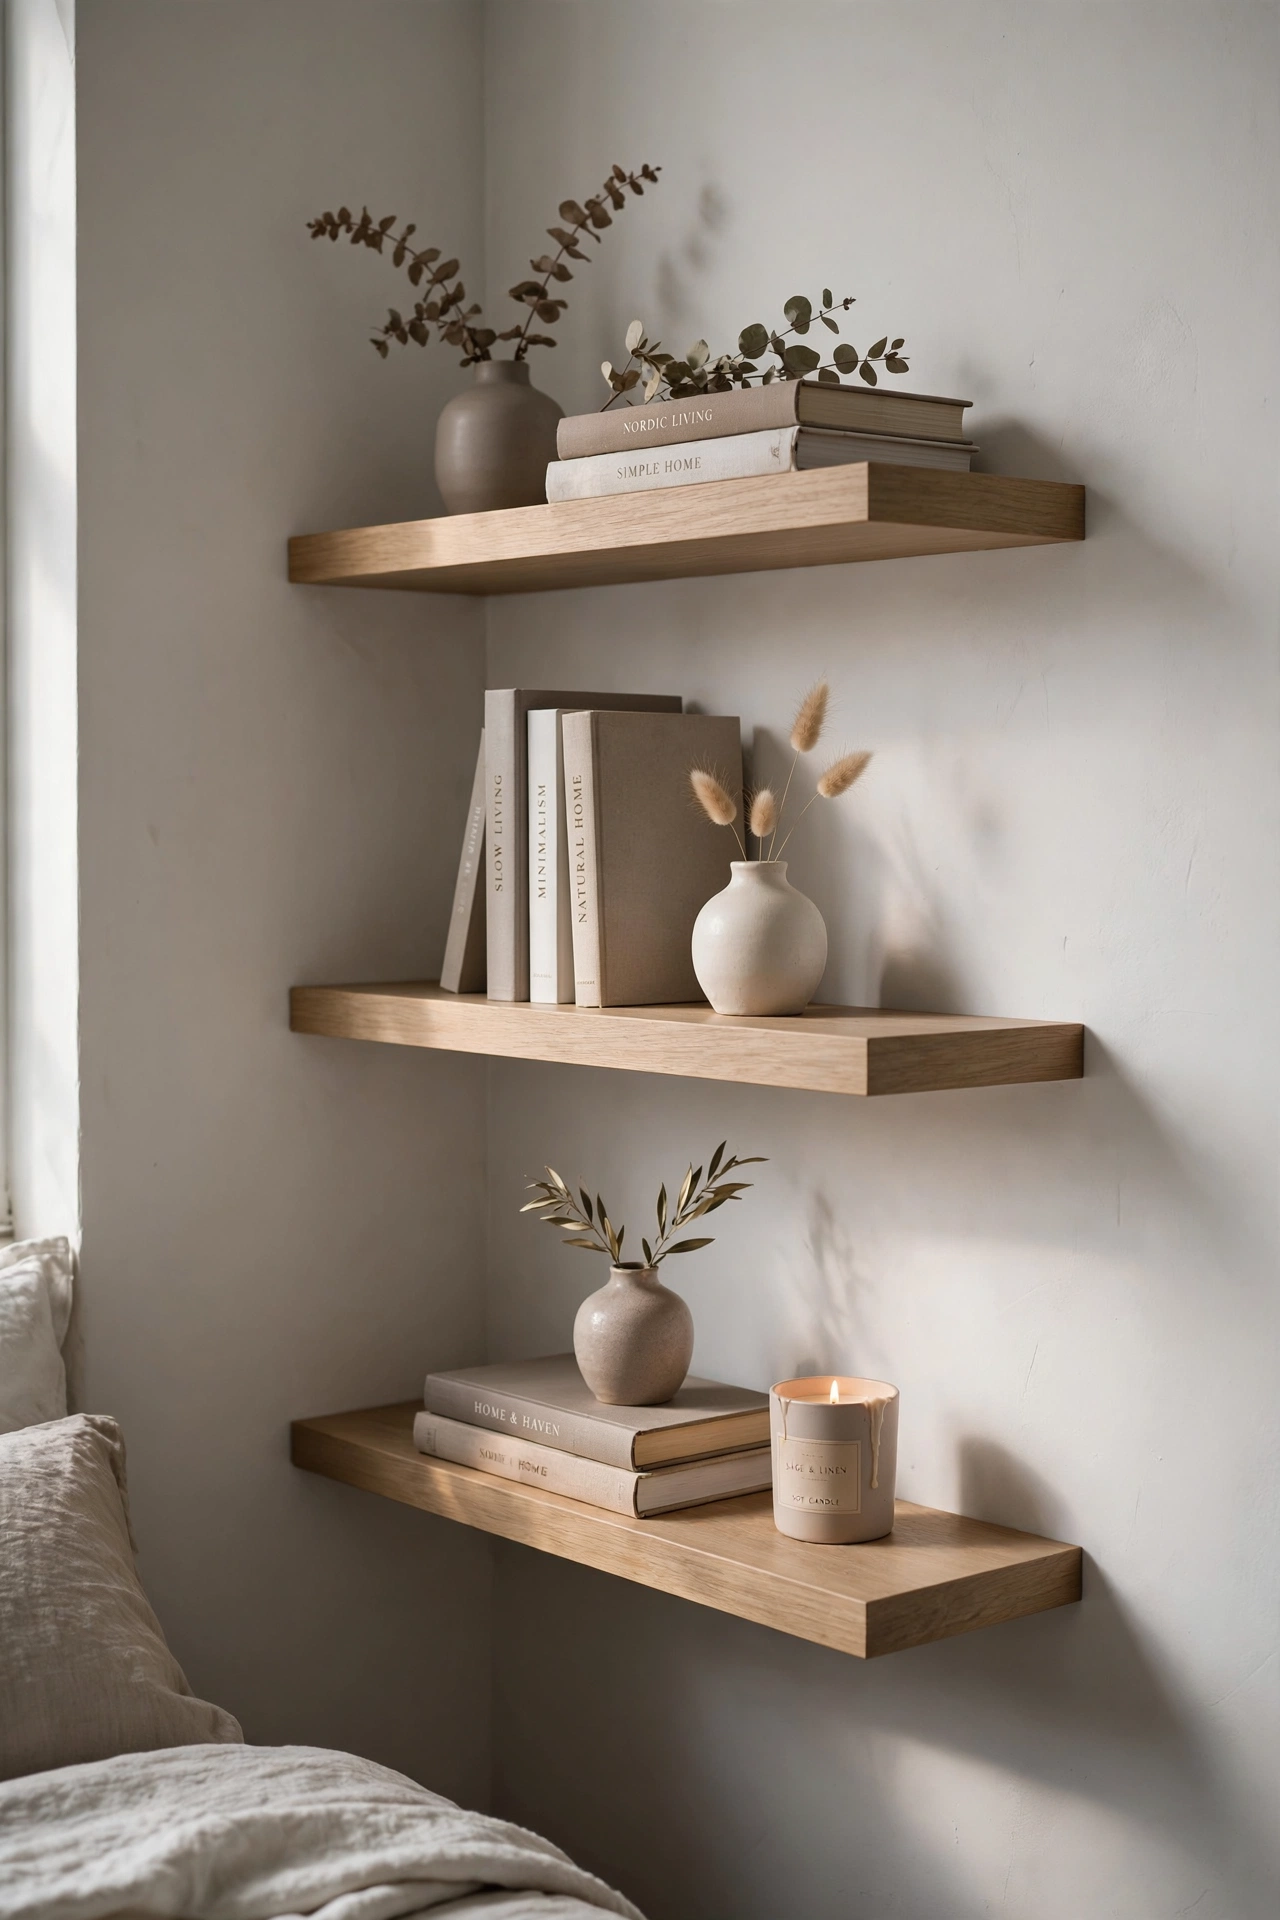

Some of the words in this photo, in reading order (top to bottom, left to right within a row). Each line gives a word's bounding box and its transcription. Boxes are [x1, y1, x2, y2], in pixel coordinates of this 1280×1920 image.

[623, 416, 668, 434] NORDIC
[672, 408, 713, 427] LIVING
[616, 462, 660, 480] SIMPLE
[664, 456, 702, 473] HOME
[494, 774, 503, 834] LIVING
[573, 774, 584, 829] HOME
[537, 784, 547, 899] MINIMALISM
[494, 844, 503, 892] SLOW
[576, 837, 587, 923] NATURAL
[474, 1401, 506, 1421] HOME
[509, 1411, 518, 1425] &
[522, 1415, 560, 1437] HAVEN
